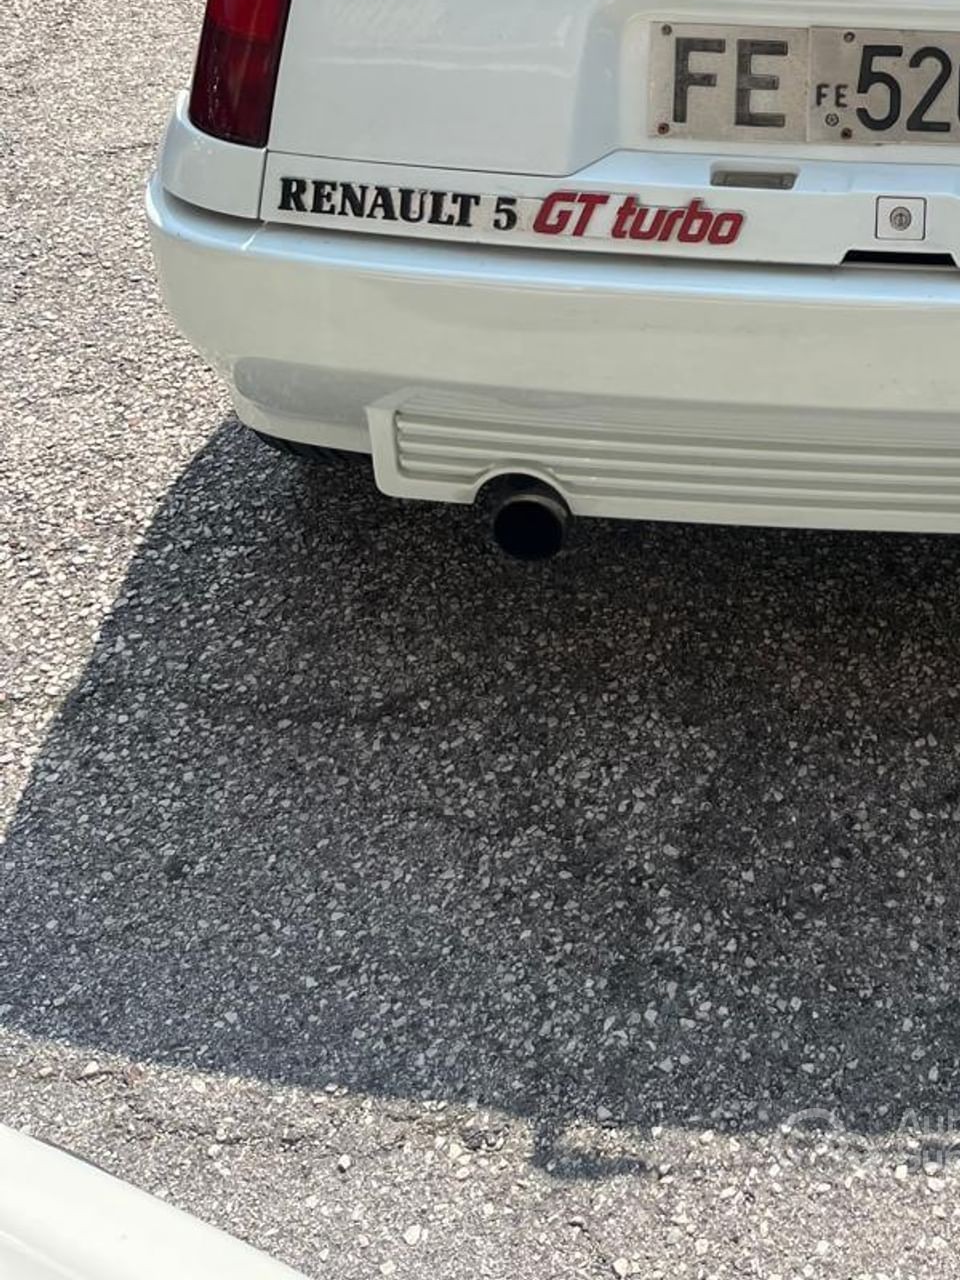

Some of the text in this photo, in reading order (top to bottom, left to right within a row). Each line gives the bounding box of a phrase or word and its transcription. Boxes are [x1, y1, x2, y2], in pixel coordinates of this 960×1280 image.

[673, 37, 788, 127] FE
[815, 83, 849, 108] FE
[278, 177, 745, 245] RENAULT 5 GT turbo
